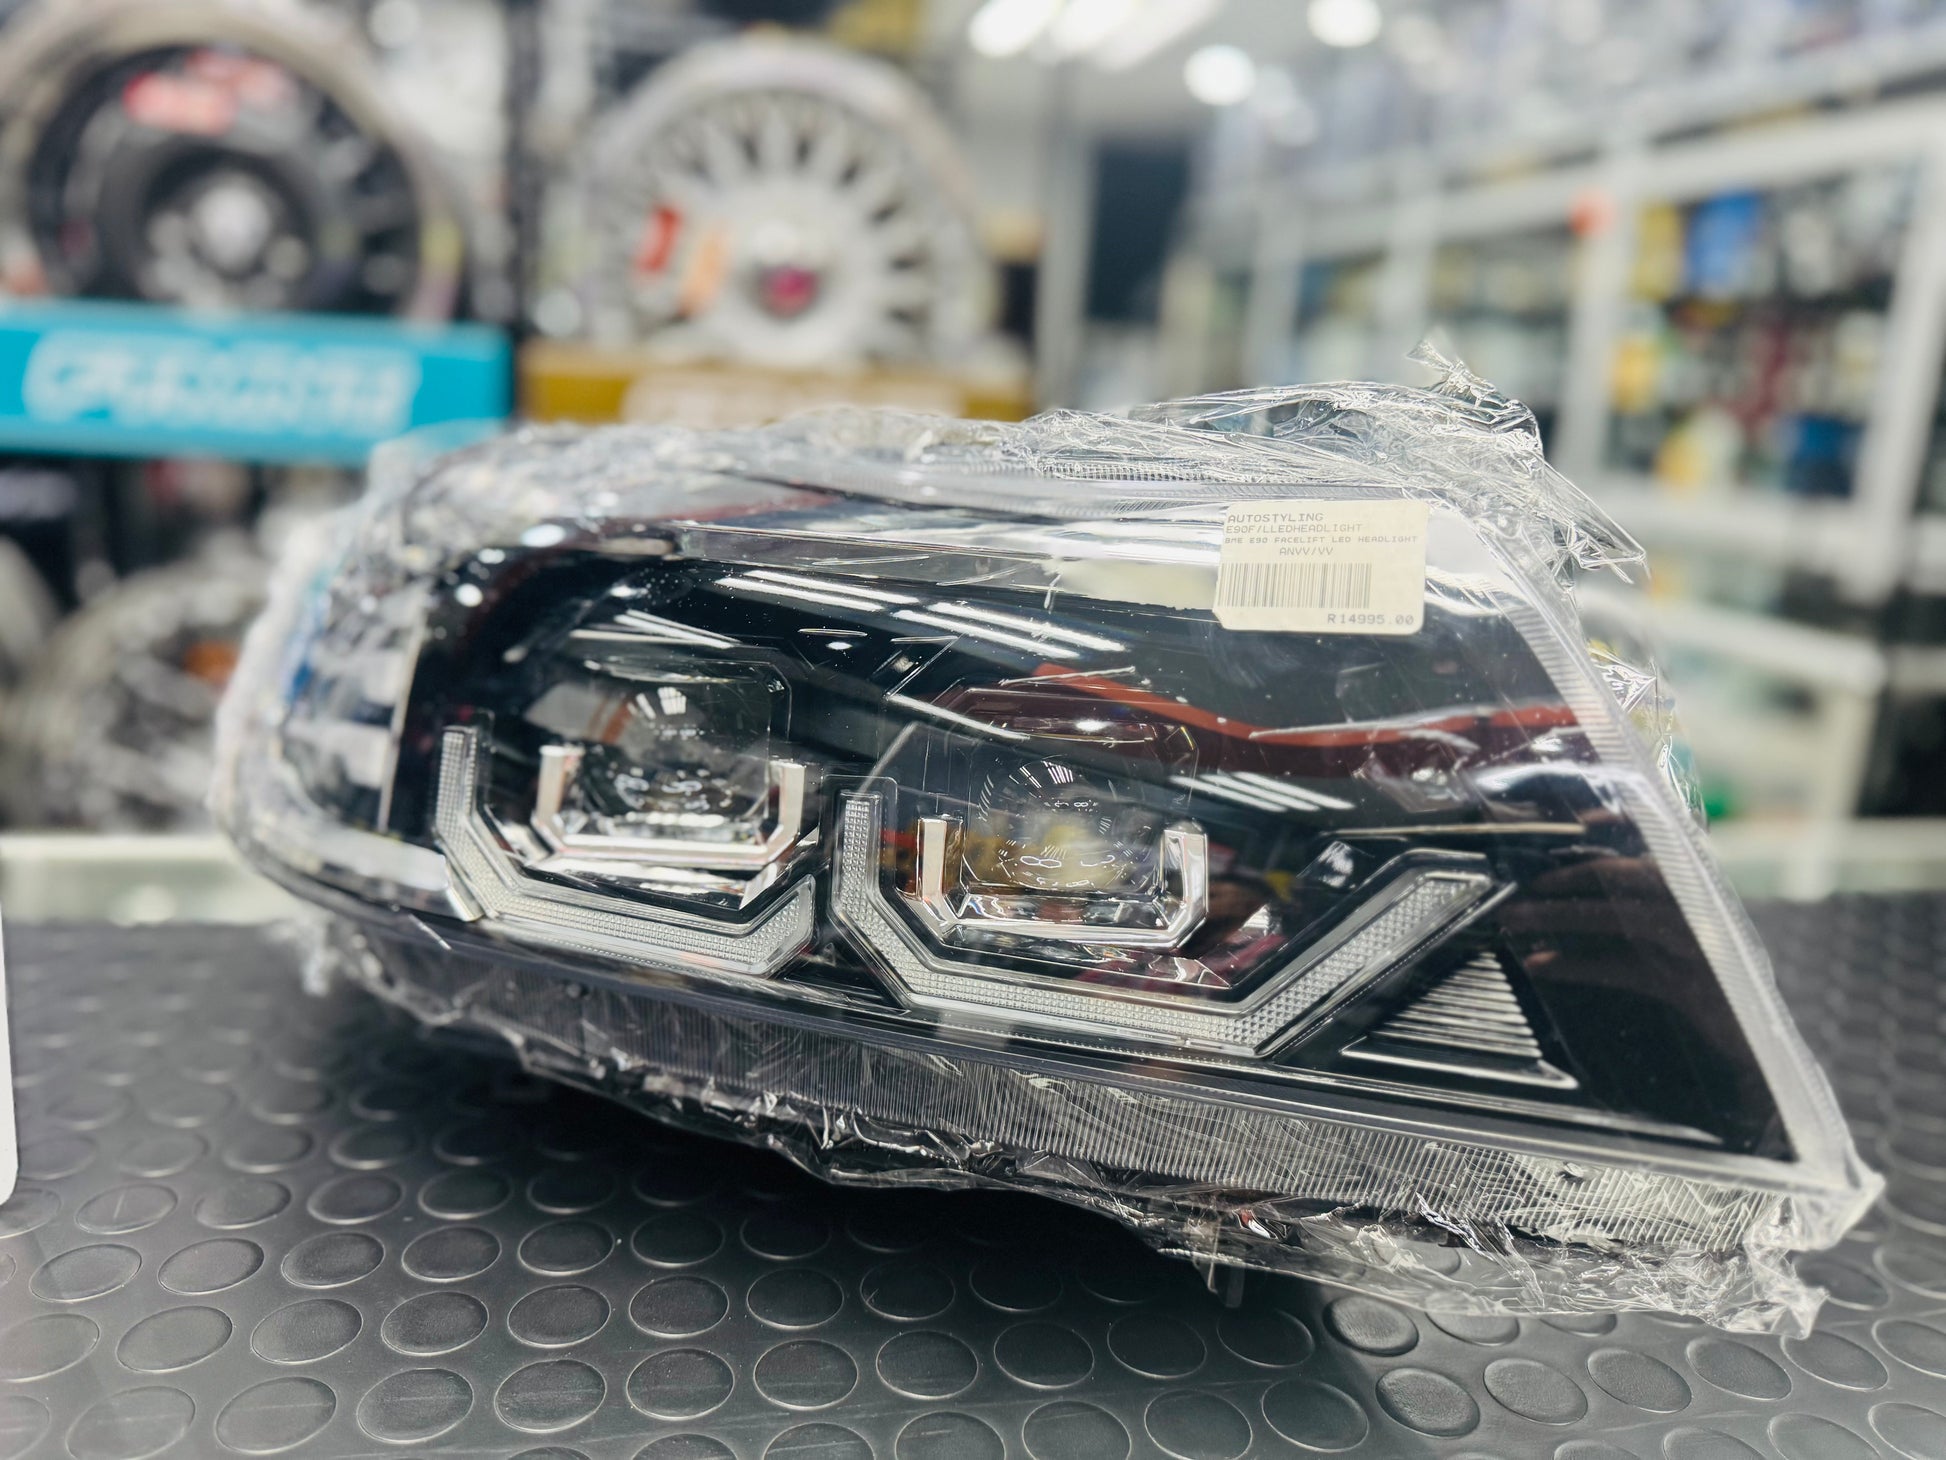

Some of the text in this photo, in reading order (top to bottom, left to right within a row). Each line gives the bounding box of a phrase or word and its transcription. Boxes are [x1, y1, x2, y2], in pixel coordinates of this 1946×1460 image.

[1228, 512, 1325, 524] AUTOSTYLING
[1249, 536, 1268, 544] E90
[1274, 536, 1326, 544] FACELIFT
[1358, 535, 1418, 543] HEADLIGHT
